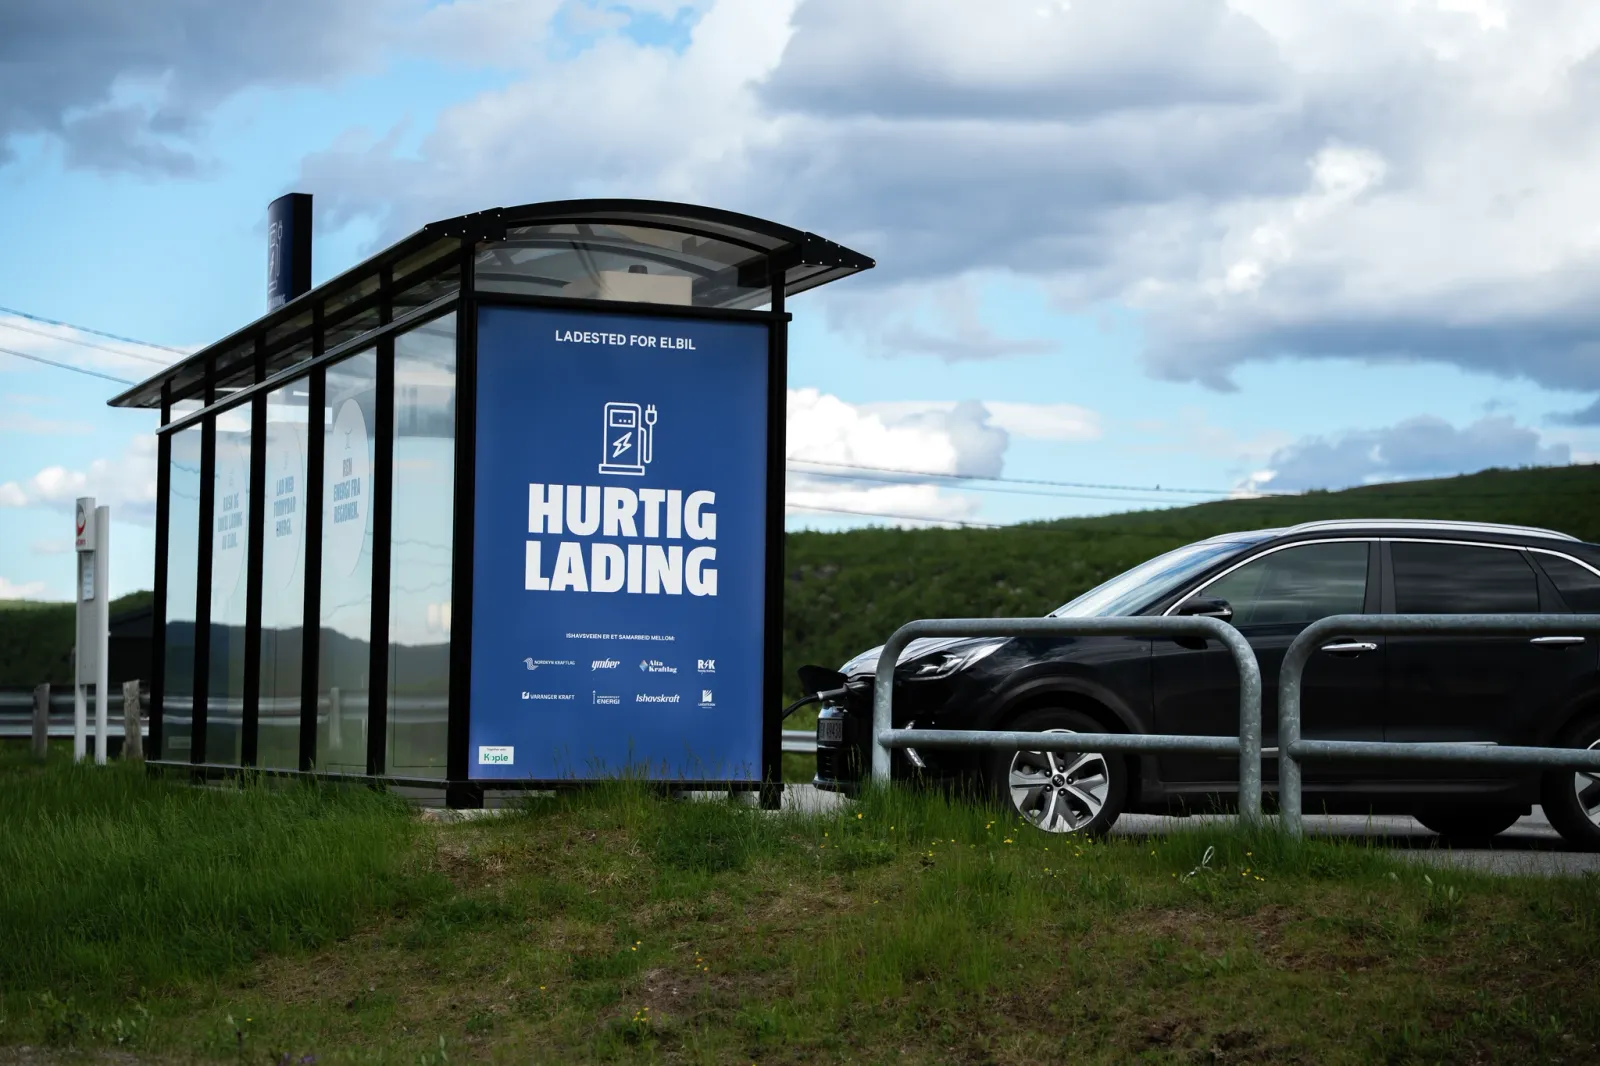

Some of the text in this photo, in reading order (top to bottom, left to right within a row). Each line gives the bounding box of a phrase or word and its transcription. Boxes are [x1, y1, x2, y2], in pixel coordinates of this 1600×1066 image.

[555, 330, 696, 350] LADESTED FOR ELBIL
[528, 483, 717, 540] HURTIG
[524, 540, 718, 596] LADING
[591, 658, 620, 672] ymber
[636, 694, 680, 703] Ishavskraft
